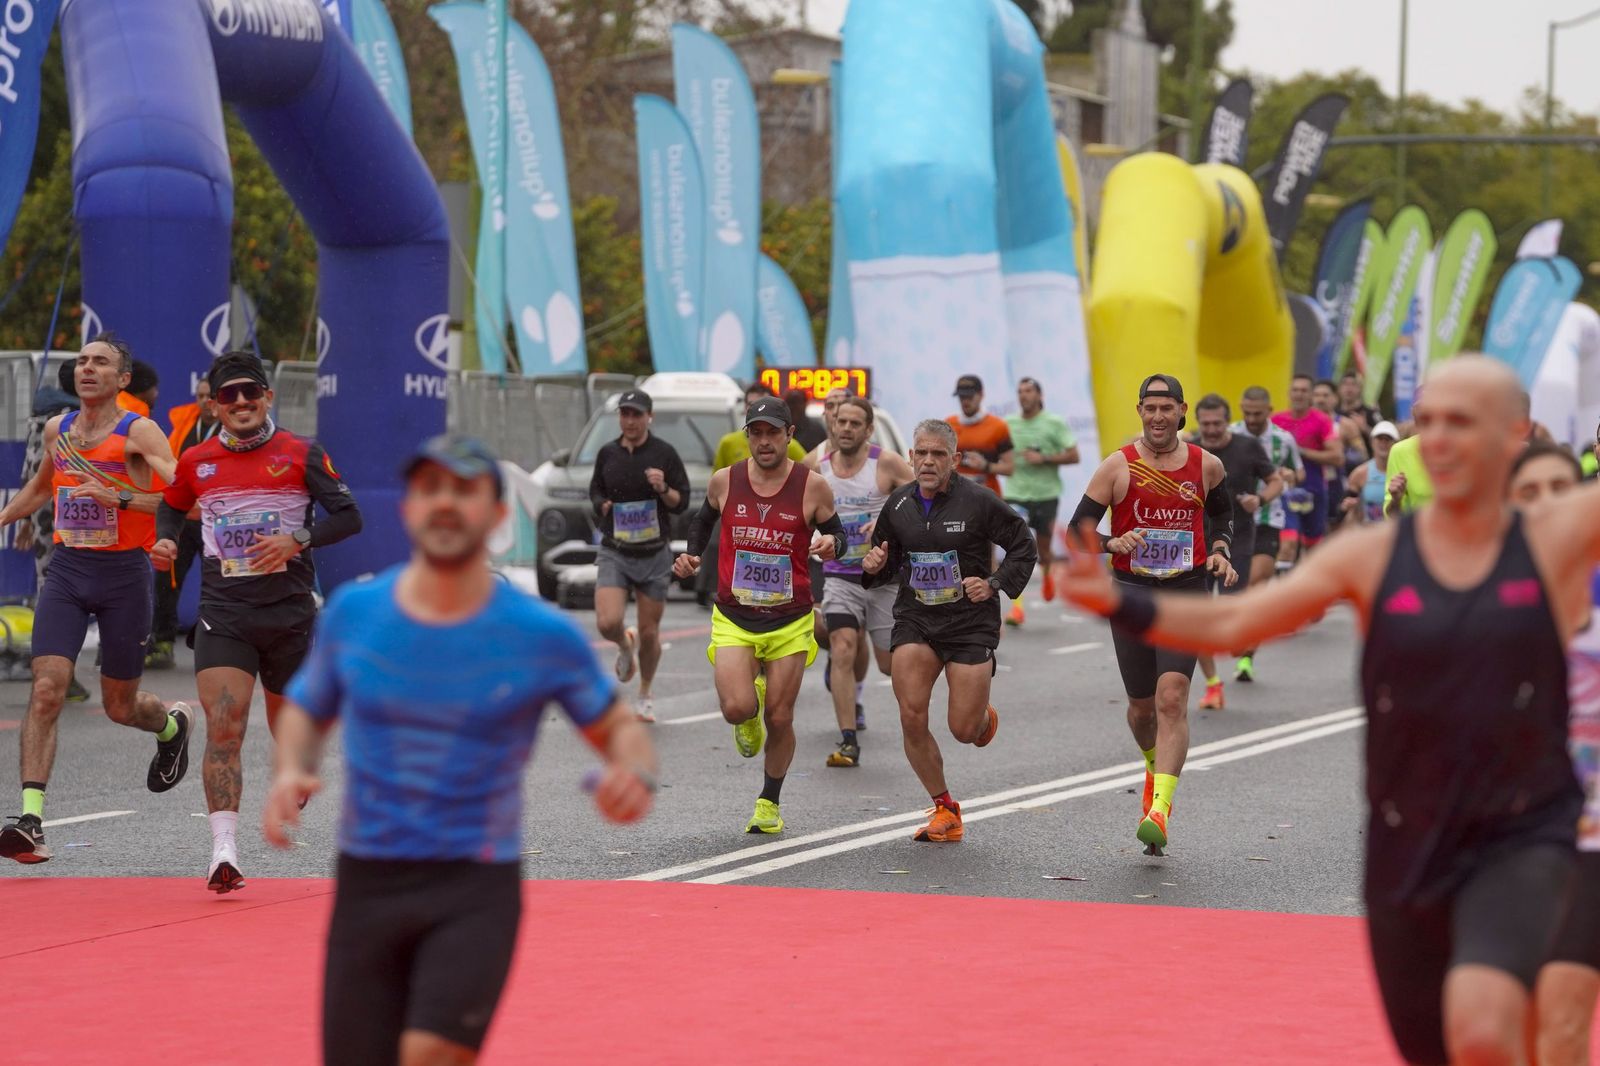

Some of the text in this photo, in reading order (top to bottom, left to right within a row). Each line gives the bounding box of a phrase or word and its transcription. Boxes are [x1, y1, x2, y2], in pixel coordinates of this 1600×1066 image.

[63, 502, 100, 520] 2353
[1141, 543, 1179, 561] 2510
[743, 565, 780, 584] 2503
[914, 566, 947, 582] 2201
